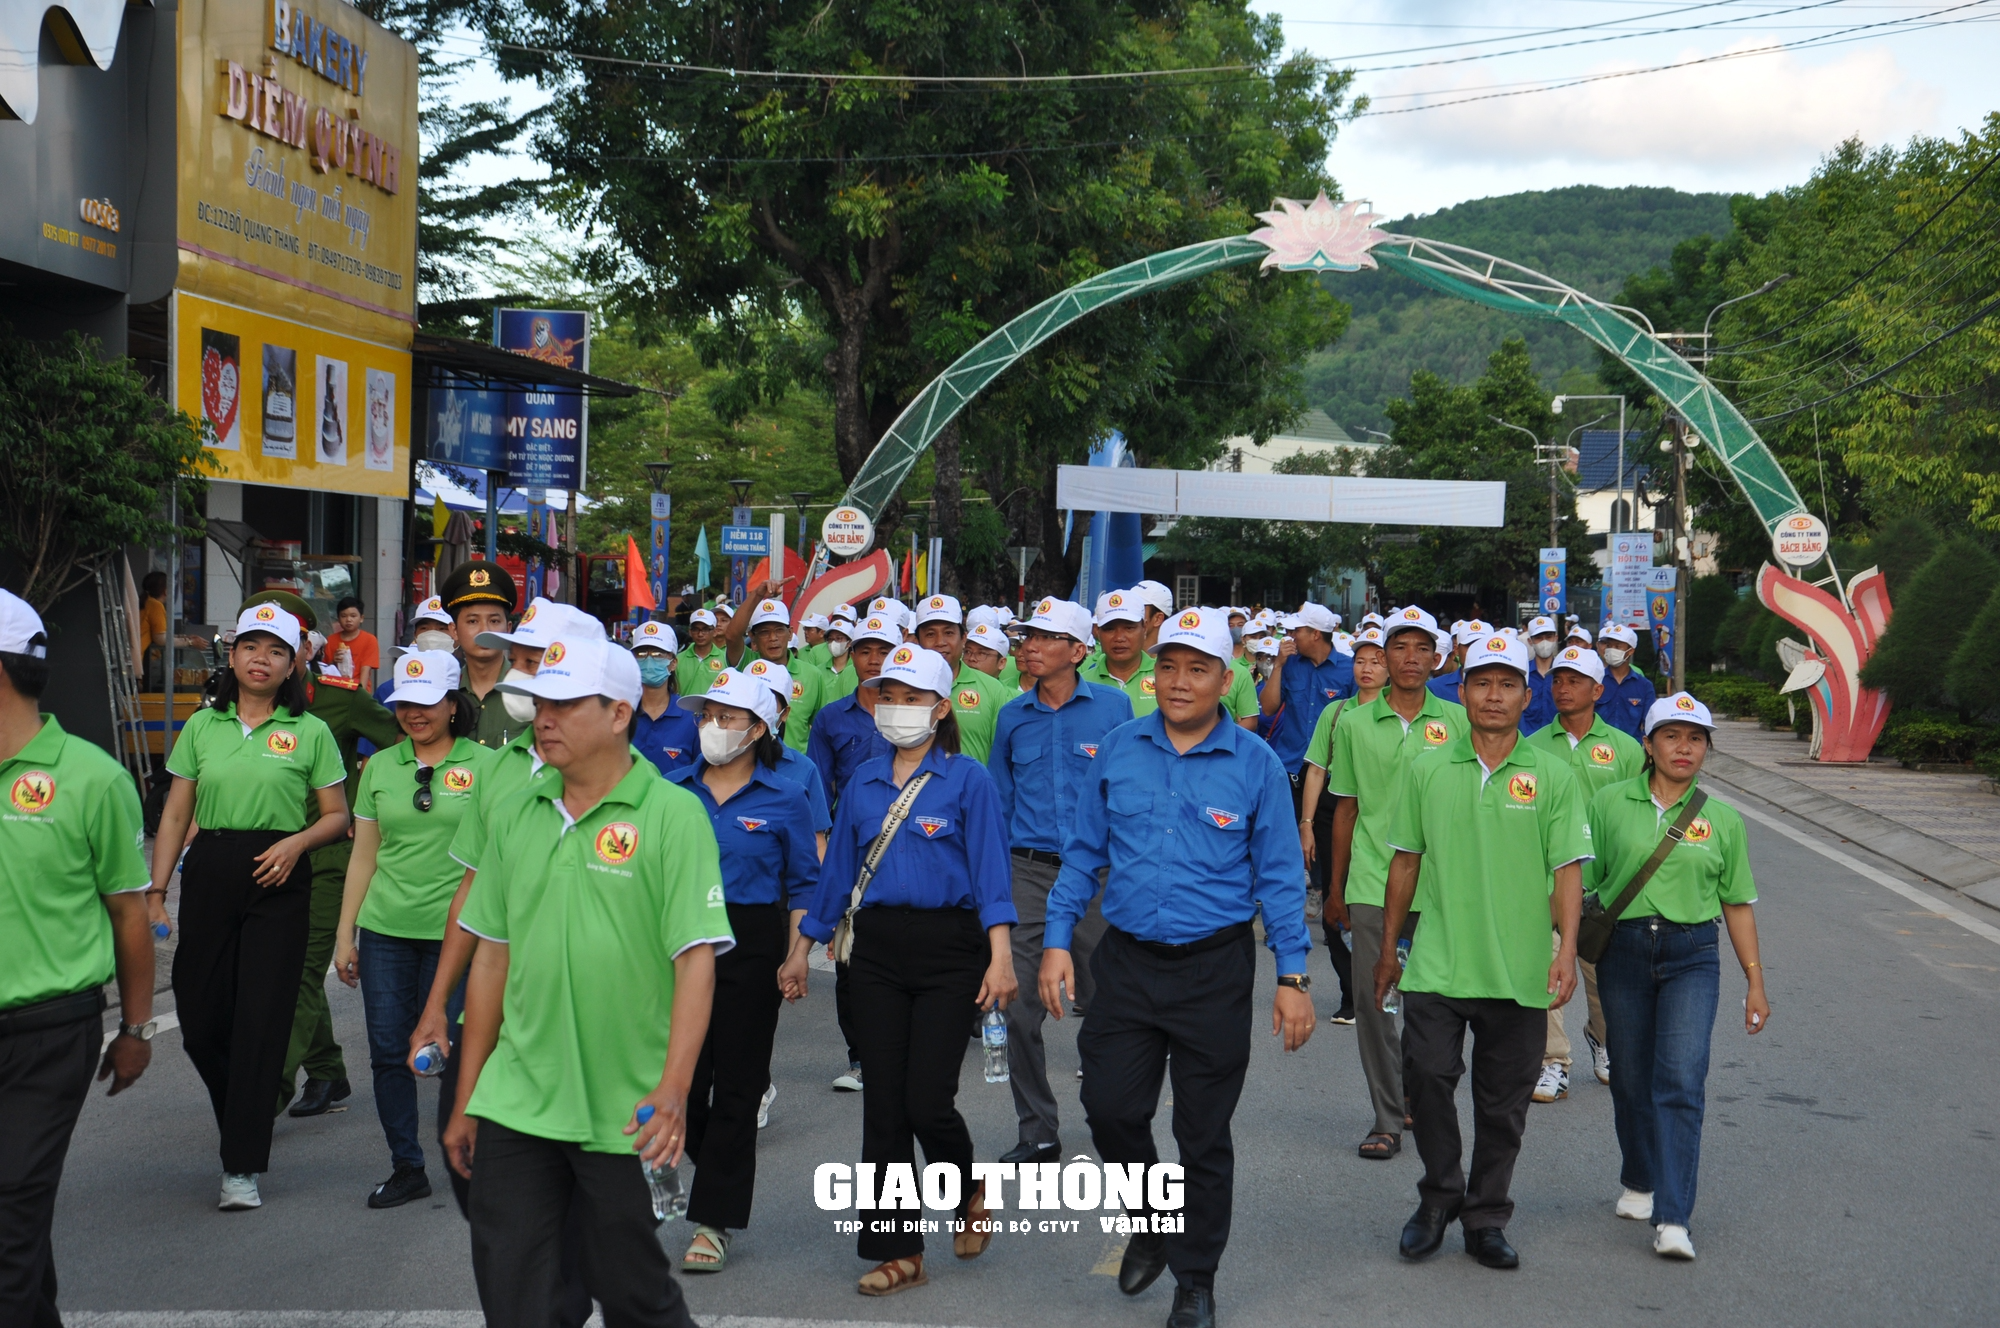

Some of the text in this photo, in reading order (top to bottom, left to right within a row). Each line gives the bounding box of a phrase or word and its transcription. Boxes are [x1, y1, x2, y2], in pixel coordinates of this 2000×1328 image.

[271, 0, 369, 96] BAKERY
[314, 107, 400, 195] QUỲNH
[245, 146, 371, 251] Bánh ngon mỗi ngày
[244, 218, 272, 246] QUANG
[531, 418, 577, 439] SANG
[730, 529, 747, 540] HẺM
[828, 530, 864, 544] BÁCH BẰNG
[725, 541, 732, 550] ĐỖ
[750, 542, 766, 552] THẮNG
[1780, 538, 1822, 552] BÁCH BẰNG
[1618, 554, 1632, 562] HỘI
